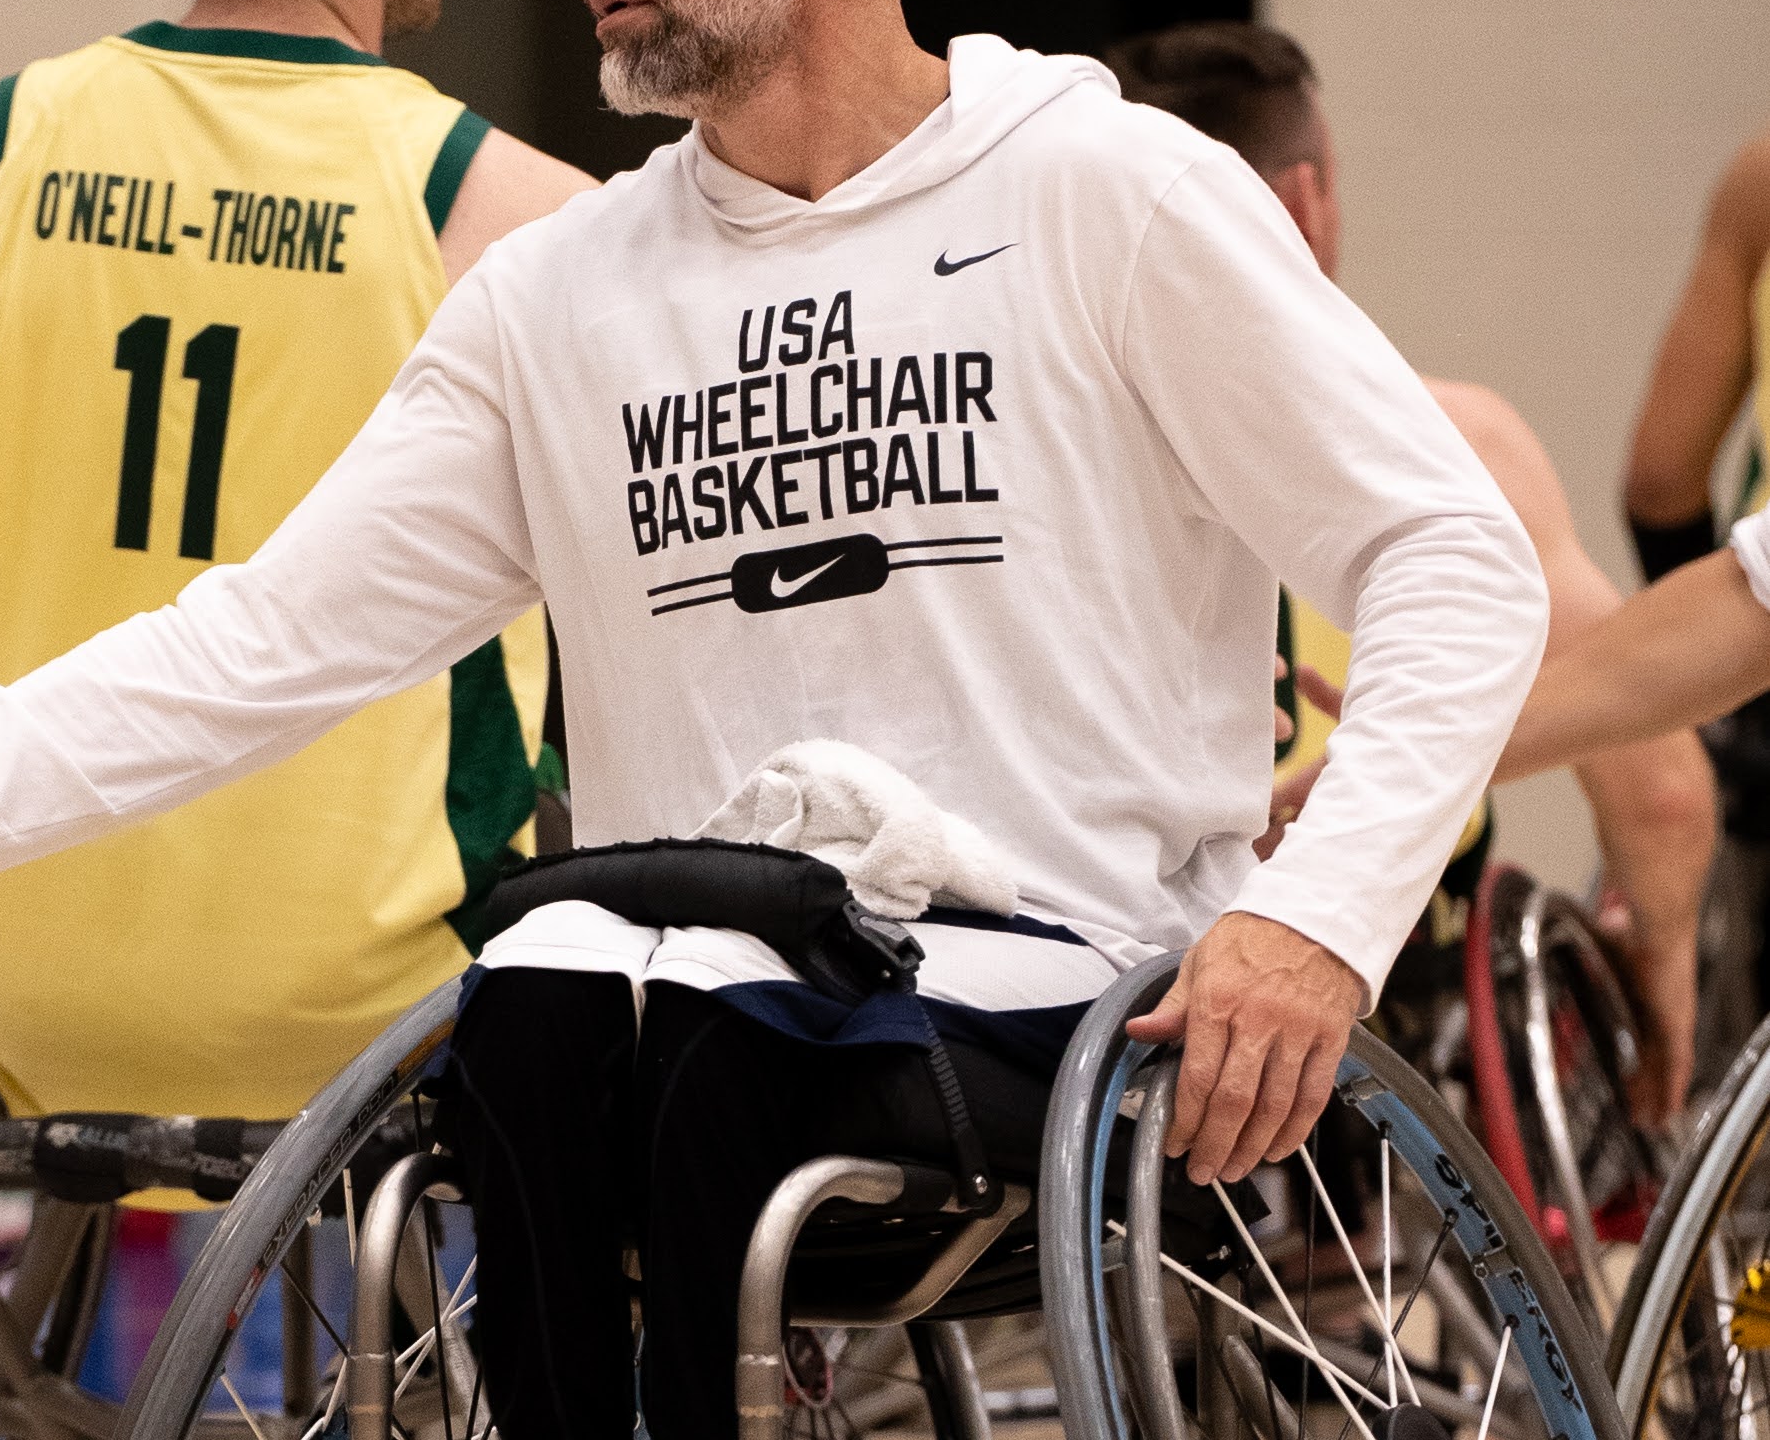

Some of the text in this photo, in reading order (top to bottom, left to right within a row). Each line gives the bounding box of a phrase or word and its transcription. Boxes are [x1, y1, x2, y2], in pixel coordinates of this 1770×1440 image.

[35, 170, 356, 274] O'NEILL-THORNE
[738, 289, 855, 373] USA
[114, 314, 240, 562] 11
[622, 351, 997, 473] WHEELCHAIR
[627, 430, 999, 557] BASKETBALL
